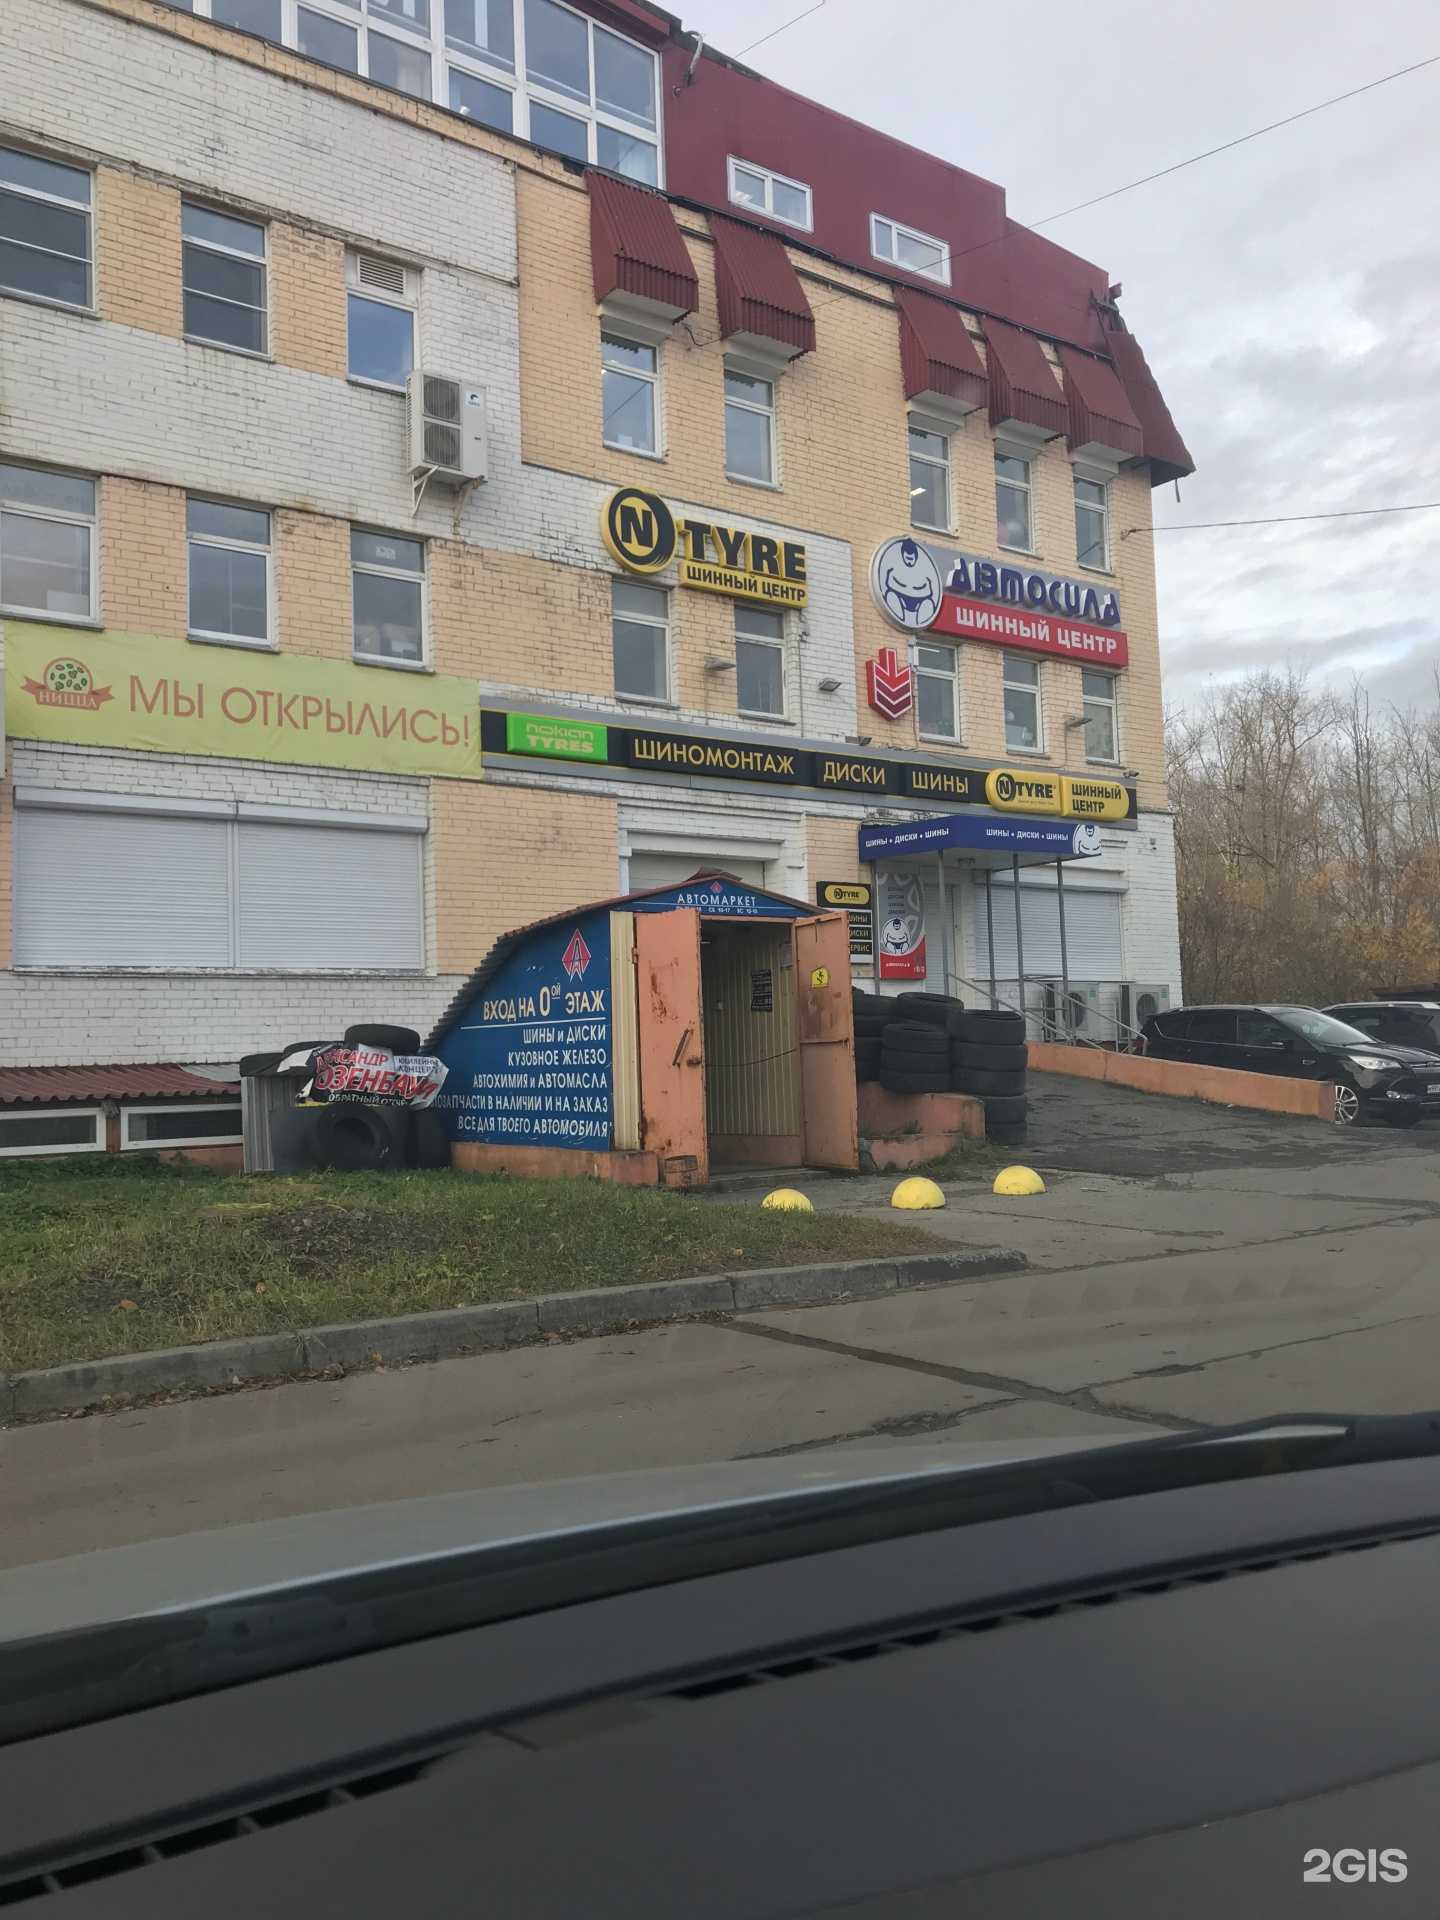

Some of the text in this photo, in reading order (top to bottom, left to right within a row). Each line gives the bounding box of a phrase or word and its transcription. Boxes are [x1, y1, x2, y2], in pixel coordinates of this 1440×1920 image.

[678, 519, 806, 582] TYRE
[686, 565, 806, 601] ШИННЫЙ ЦЕНТР
[956, 606, 1117, 655] ШИННЫЙ ЦЕНТР
[129, 675, 469, 747] МЫ ОТКРЫЛИСЬ!
[528, 735, 594, 753] TYRES
[634, 737, 796, 775] ШИНОМОНТАЖ
[823, 760, 886, 785] ДИСКИ
[912, 770, 969, 794] ШИНЫ
[1015, 781, 1054, 799] TYRE
[1072, 783, 1122, 800] ШИННЫЙ
[1072, 799, 1105, 813] ЦЕНТР
[894, 833, 918, 844] ДИСКИ
[924, 827, 949, 839] ШИНЫ
[986, 828, 1069, 841] ШИНЫ ДИСКИ ШИНЫ
[677, 893, 756, 906] АВТОМАРКЕТ
[848, 944, 870, 952] ЕРВИС
[483, 999, 516, 1022] ВХОД
[519, 997, 536, 1018] НА
[565, 990, 605, 1014] ЭТАЖ
[523, 1028, 555, 1044] ШИНЫ
[566, 1025, 606, 1044] ДИСКИ
[508, 1048, 606, 1066] КУЗОВНОЕ ЖЕЛЕЗО
[472, 1074, 528, 1089] АВТОХИМИЯ
[538, 1073, 607, 1089] АВТОМАСЛА
[487, 1095, 494, 1109] В
[496, 1096, 542, 1111] НАЛИЧИИ
[545, 1096, 553, 1111] И
[555, 1097, 571, 1112] НА
[573, 1097, 608, 1113] ЗАКАЗ
[457, 1115, 608, 1137] ВСЕ ДЛЯ ТВОЕГО АВТОМОБИЛЯ
